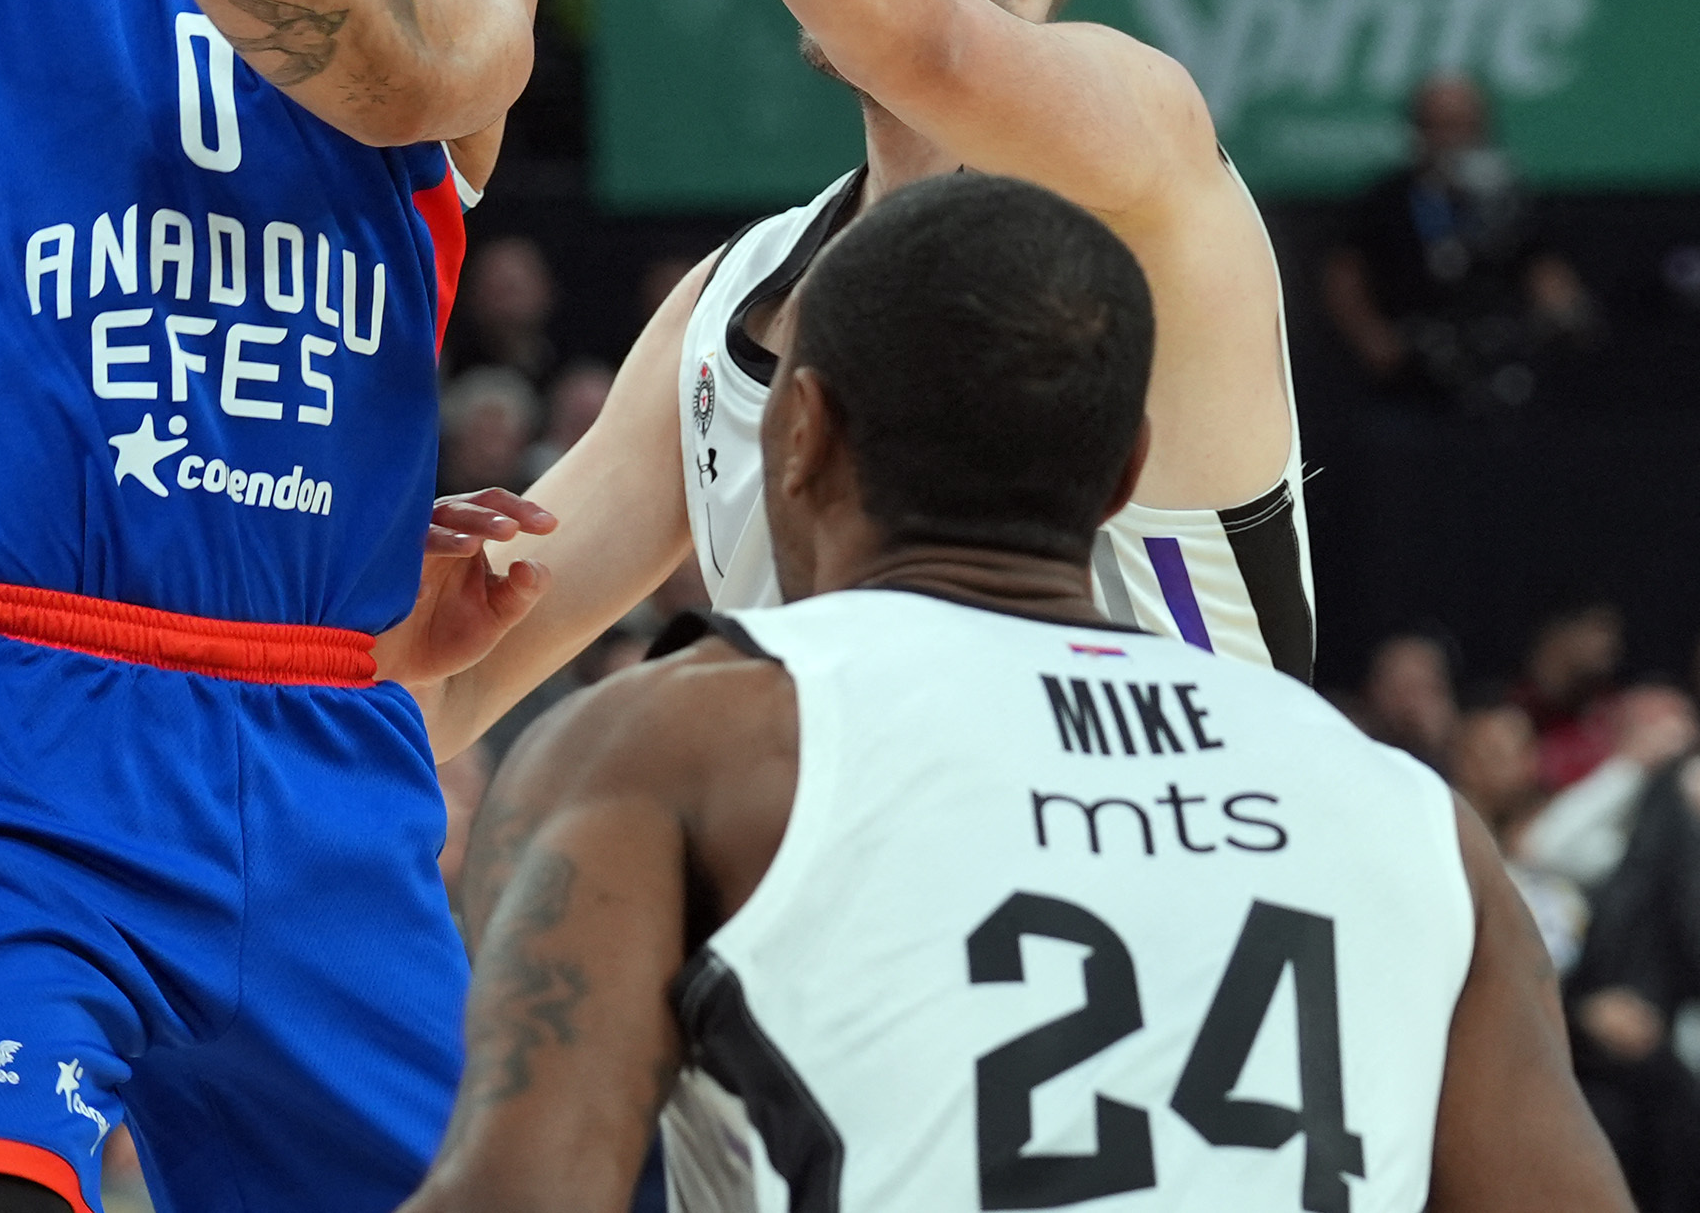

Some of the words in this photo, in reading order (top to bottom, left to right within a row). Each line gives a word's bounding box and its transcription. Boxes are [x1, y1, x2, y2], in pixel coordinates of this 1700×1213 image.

[175, 12, 242, 173] 0
[25, 203, 386, 356] ANADOLU
[91, 307, 337, 427] EFES
[176, 454, 333, 516] coendon
[1039, 673, 1224, 757] MIKE
[1029, 783, 1288, 856] mts
[966, 889, 1366, 1213] 24
